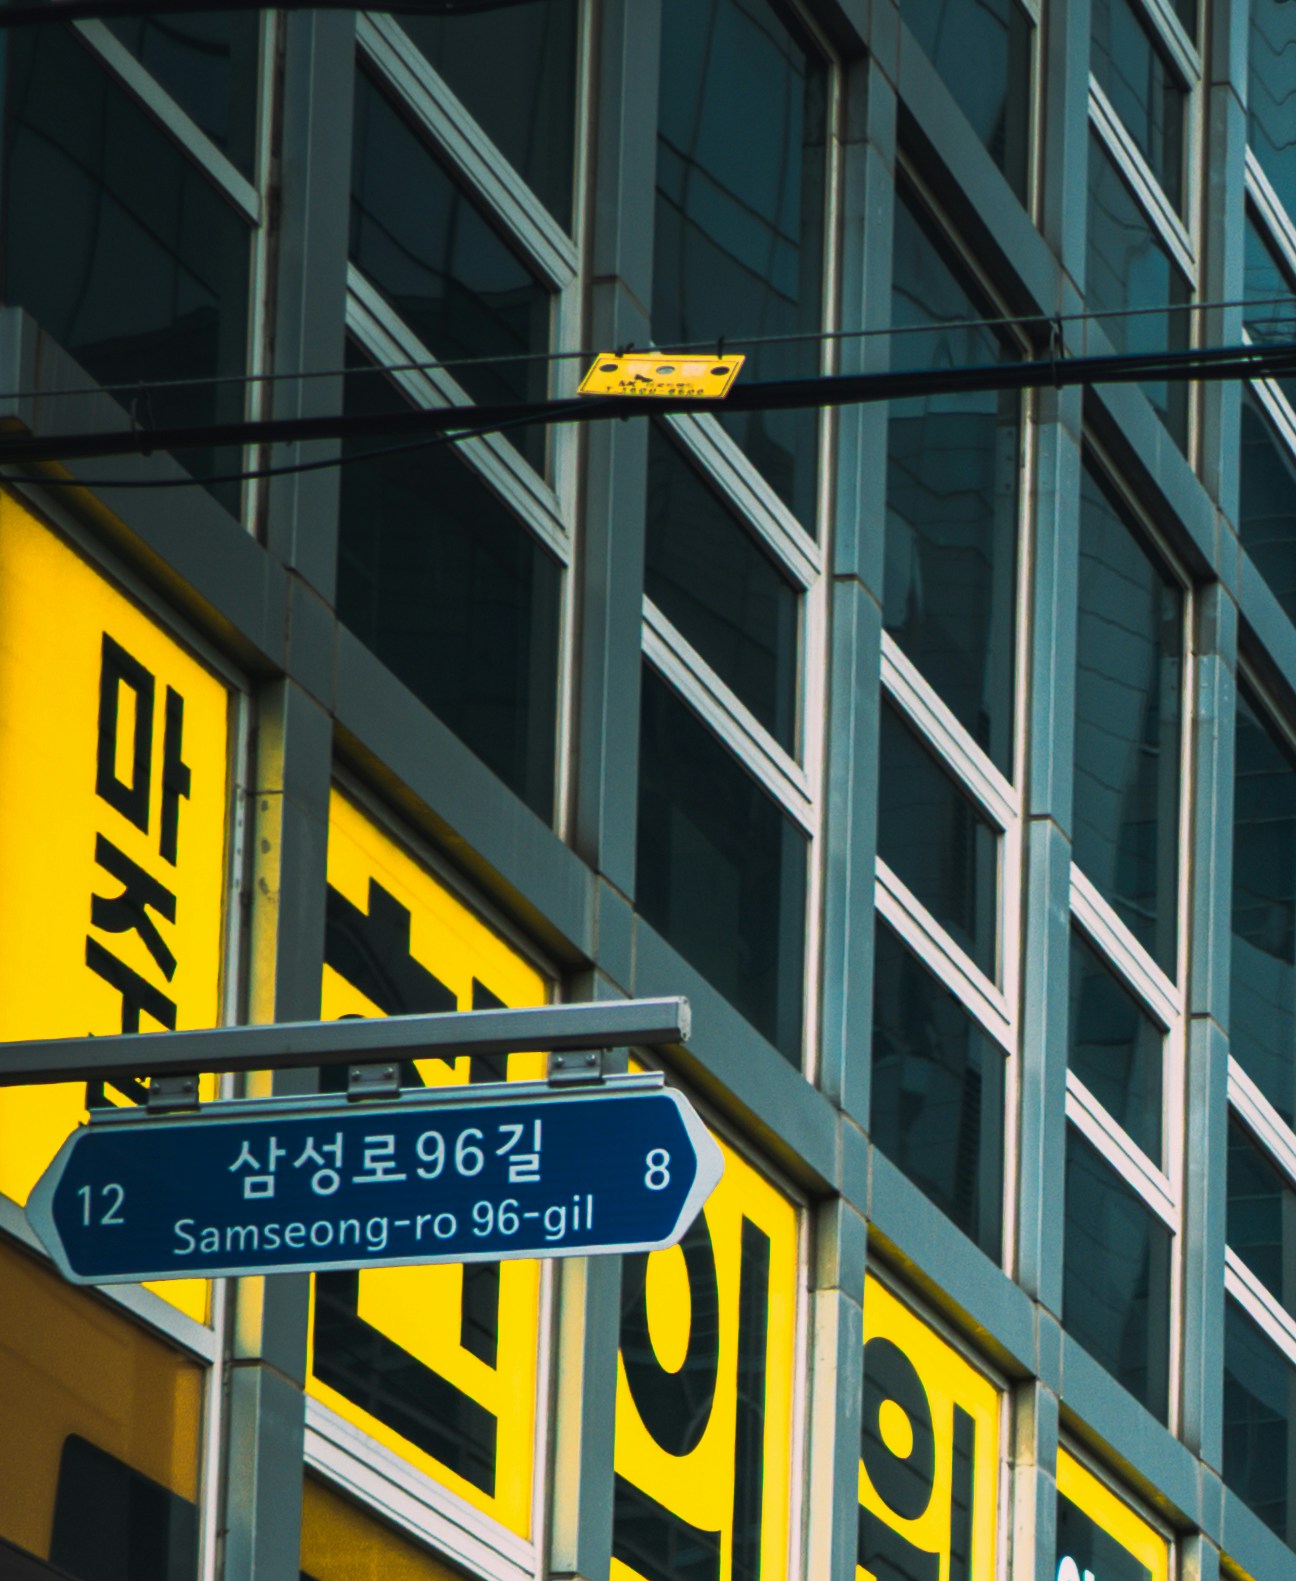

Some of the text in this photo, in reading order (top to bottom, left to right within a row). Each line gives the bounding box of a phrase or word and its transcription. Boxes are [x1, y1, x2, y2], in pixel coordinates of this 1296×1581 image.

[229, 1119, 544, 1199] 삼성로96길
[643, 1147, 672, 1191] 8
[76, 1182, 126, 1228] 12
[172, 1194, 594, 1258] Samseong-ro 96-gil
